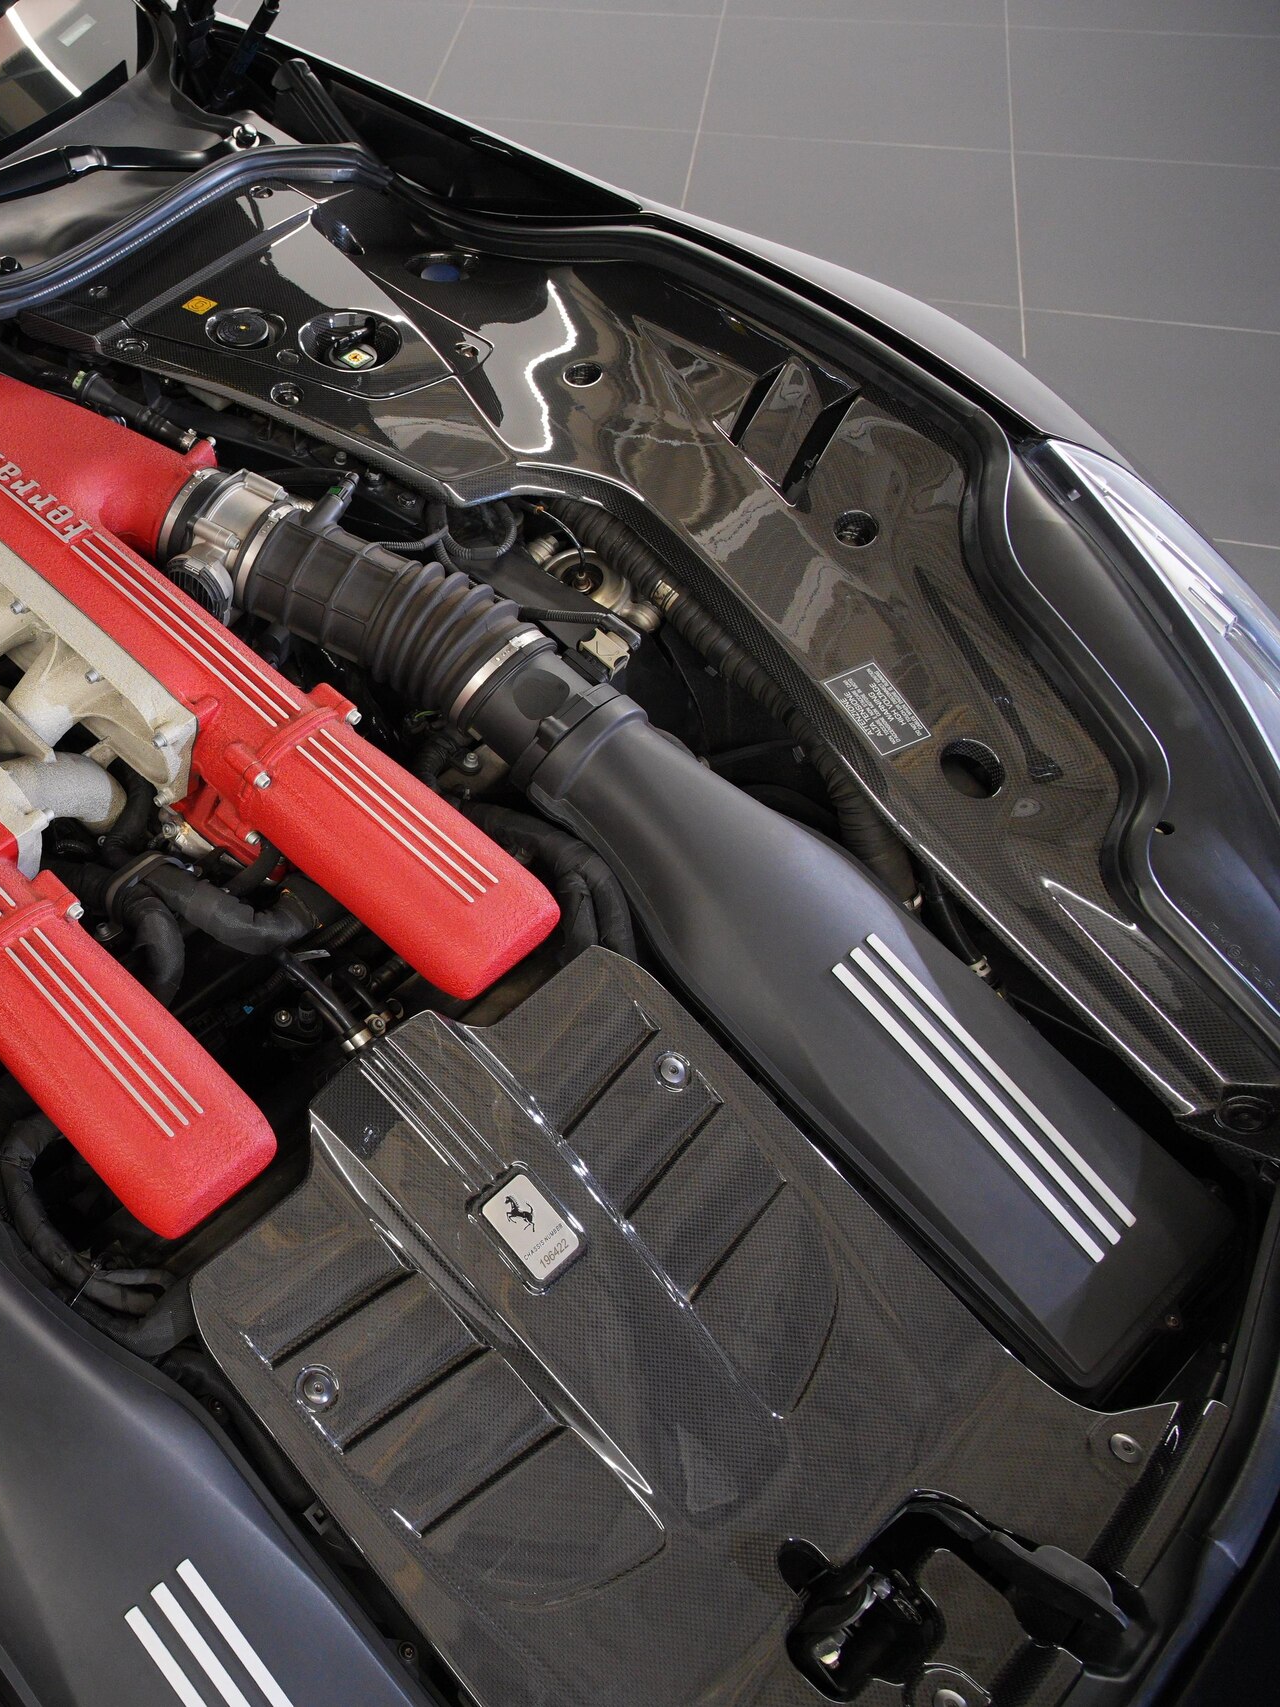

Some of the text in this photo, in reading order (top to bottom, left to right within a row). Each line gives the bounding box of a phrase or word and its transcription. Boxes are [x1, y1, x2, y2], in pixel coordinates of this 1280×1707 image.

[839, 697, 874, 735] ATTENZIONE
[843, 690, 883, 737] ALTA TENSIONE
[867, 691, 895, 721] WARNING
[868, 681, 906, 725] HIGH VOLTAGE
[523, 1222, 564, 1261] CHASSIS NUMBER
[539, 1238, 570, 1269] 196422
